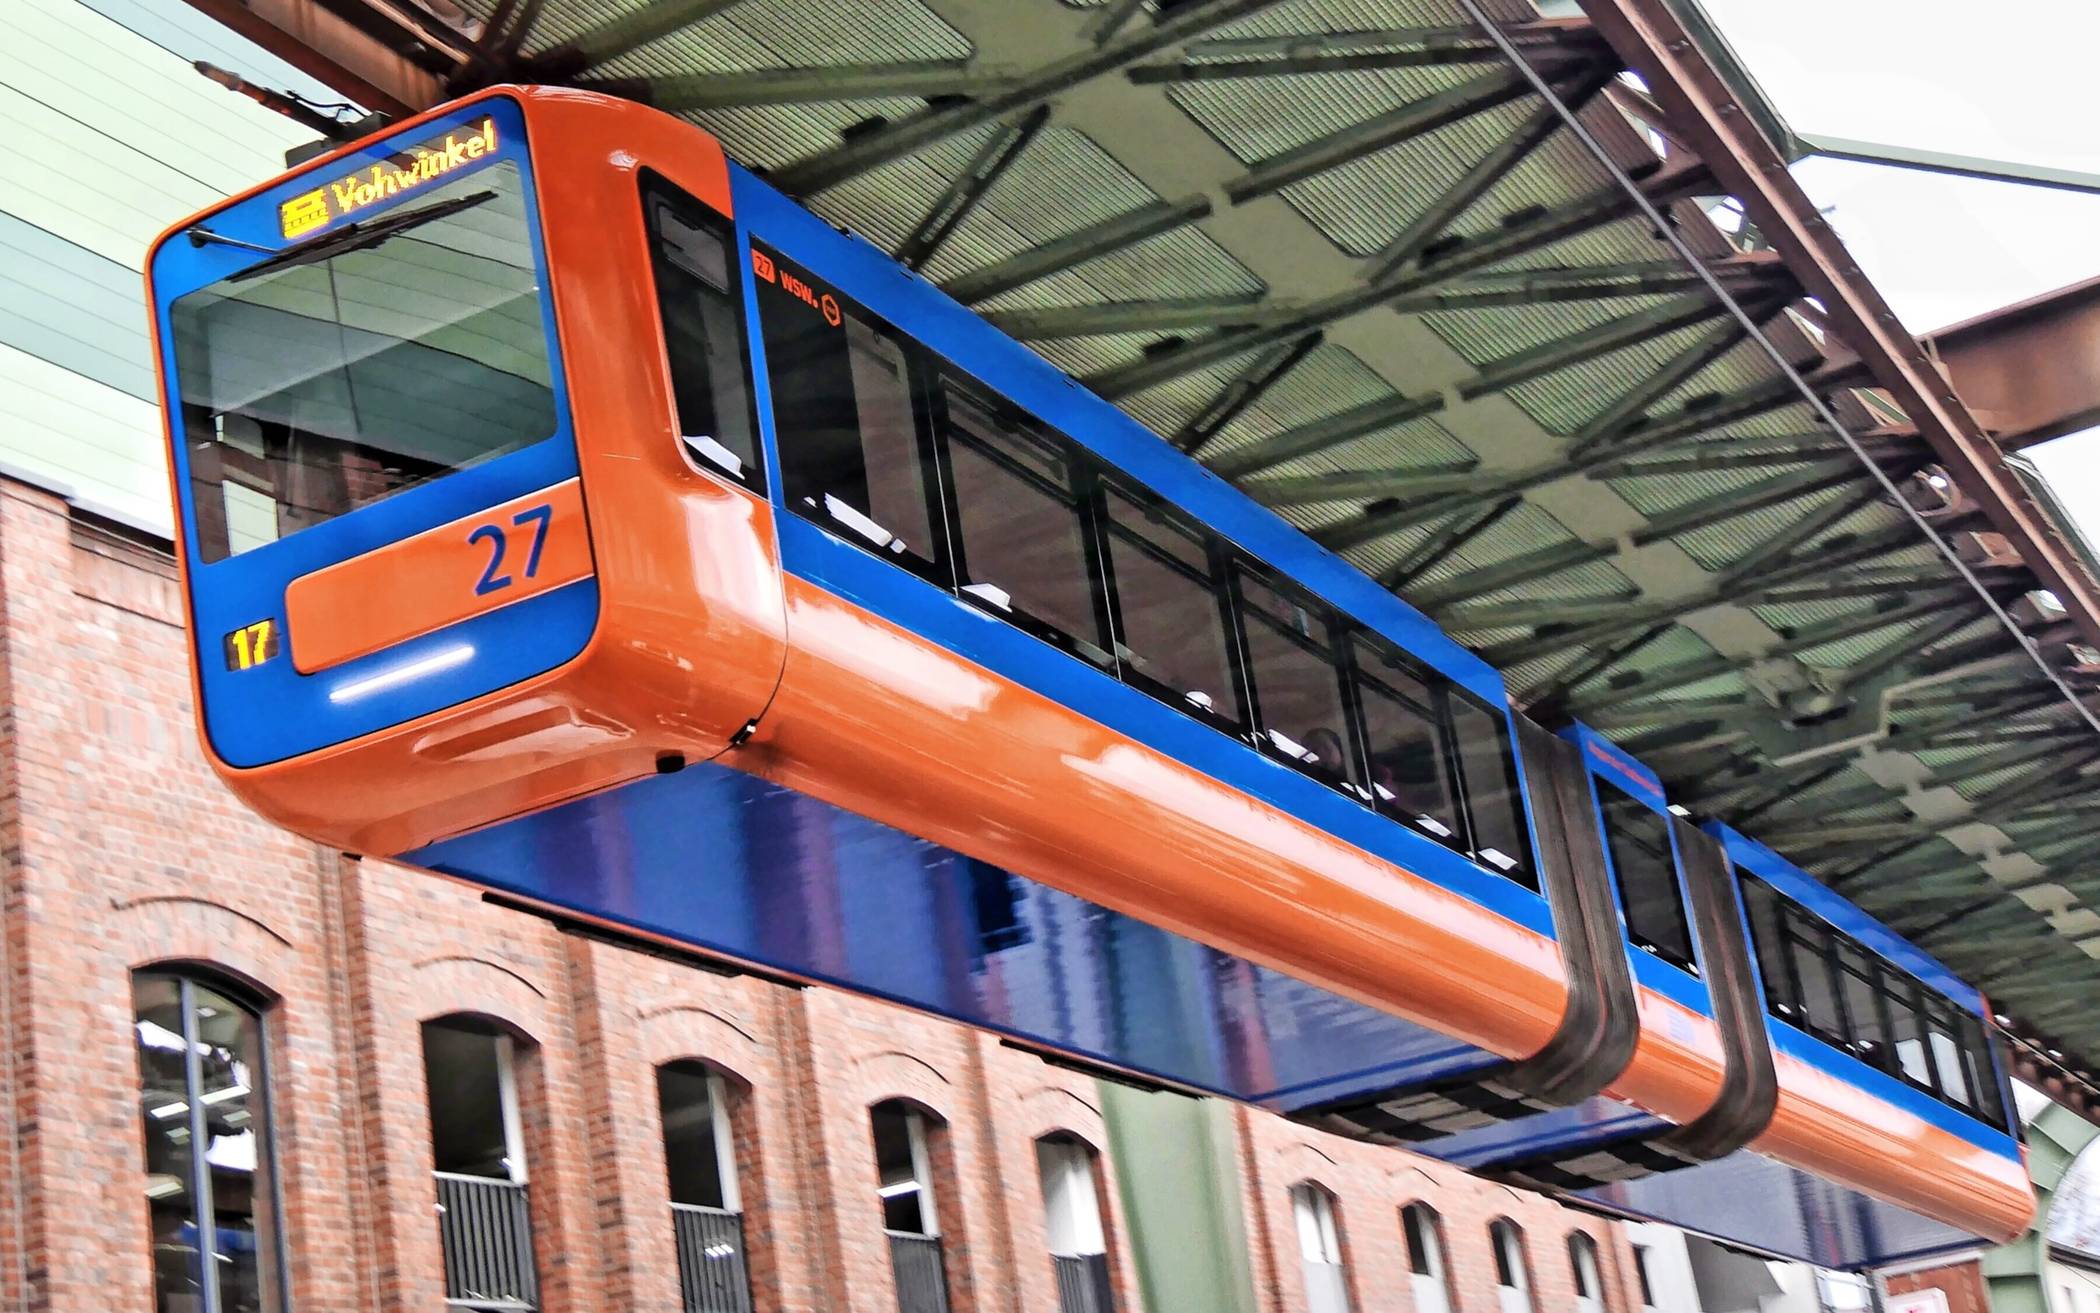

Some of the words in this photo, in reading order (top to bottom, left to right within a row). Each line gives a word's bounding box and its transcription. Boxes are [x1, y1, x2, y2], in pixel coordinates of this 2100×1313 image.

[331, 119, 496, 213] Vohwinkel
[755, 256, 771, 277] 27
[467, 504, 552, 596] 27
[231, 620, 271, 670] 17
